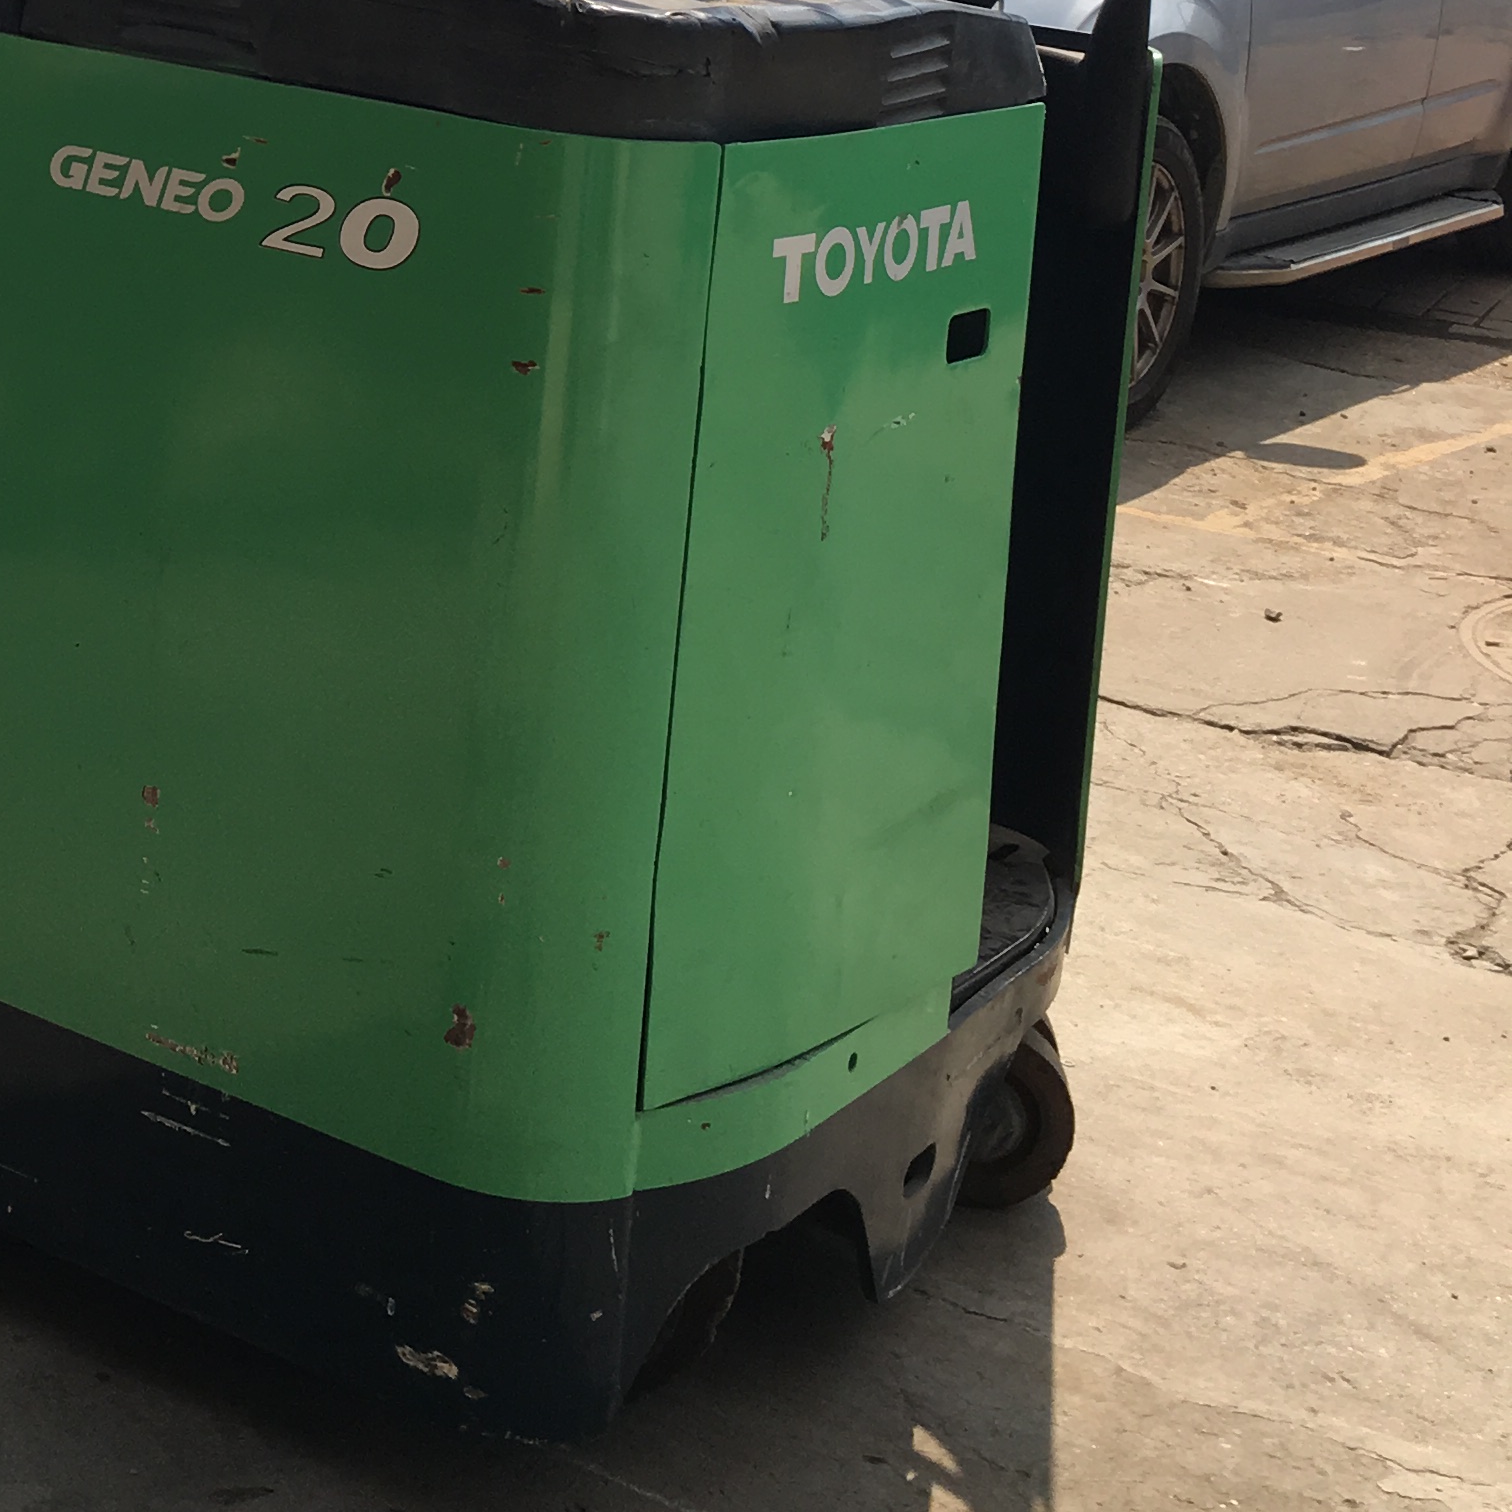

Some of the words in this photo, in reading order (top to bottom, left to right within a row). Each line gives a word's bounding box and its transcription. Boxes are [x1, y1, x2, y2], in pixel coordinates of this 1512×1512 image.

[49, 145, 245, 223] GENEO
[259, 183, 421, 271] 20
[772, 199, 977, 304] TOYOTA
